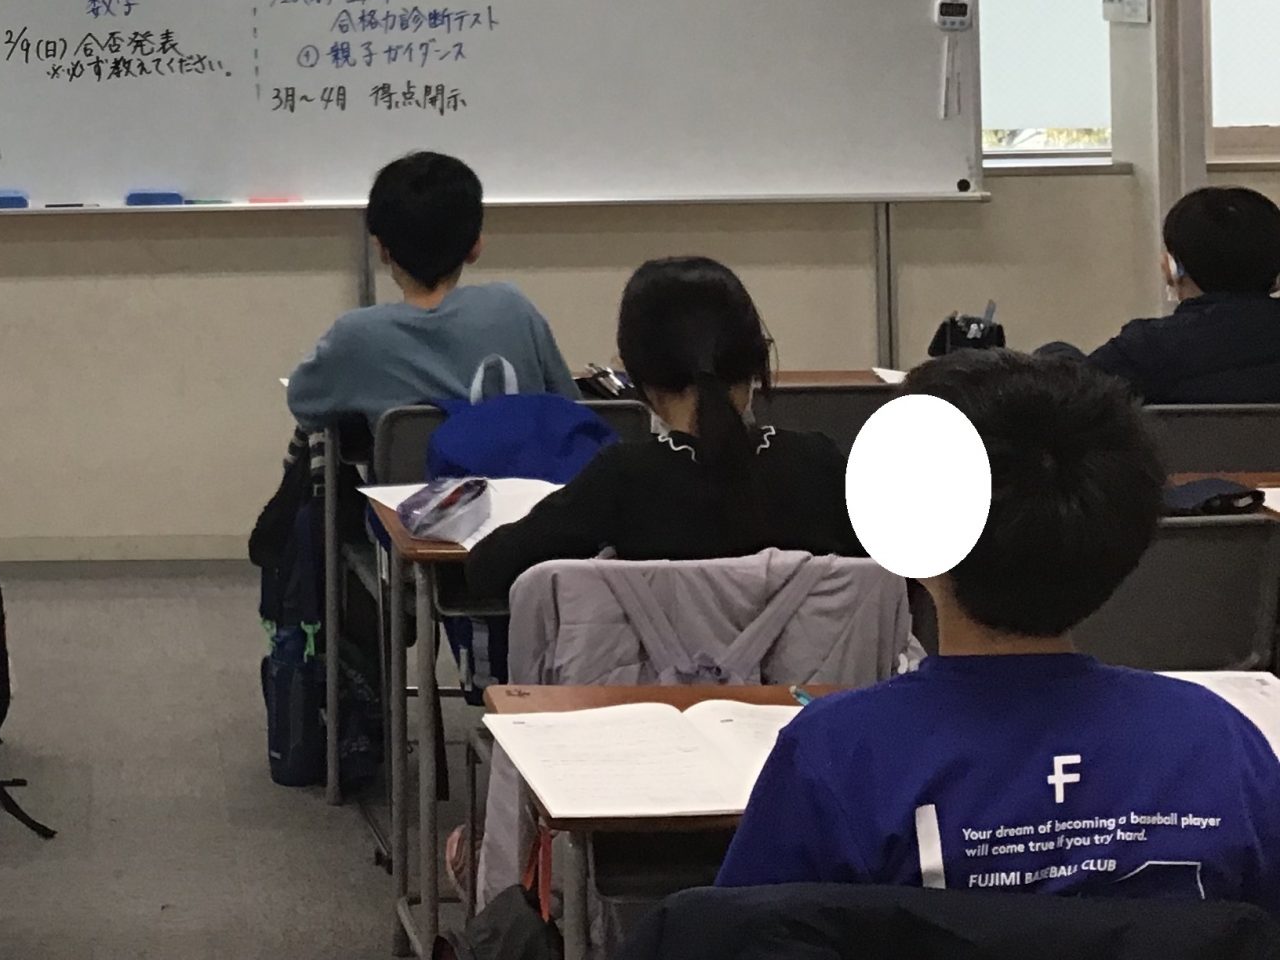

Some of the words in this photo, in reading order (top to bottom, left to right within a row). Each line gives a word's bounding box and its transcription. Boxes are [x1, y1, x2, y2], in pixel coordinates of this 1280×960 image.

[1047, 754, 1081, 804] F
[962, 827, 993, 841] Your
[995, 825, 1034, 838] dream
[1037, 823, 1052, 835] of
[1054, 816, 1116, 833] becoming
[1119, 816, 1126, 825] a
[1130, 811, 1178, 825] baseball
[1180, 813, 1222, 828] player
[965, 843, 989, 857] will
[991, 844, 1025, 856] come
[1028, 838, 1055, 852] true
[1065, 836, 1091, 849] you
[1093, 833, 1114, 845] try
[968, 872, 1020, 888] FUJIMI
[1081, 858, 1117, 872] CLUB
